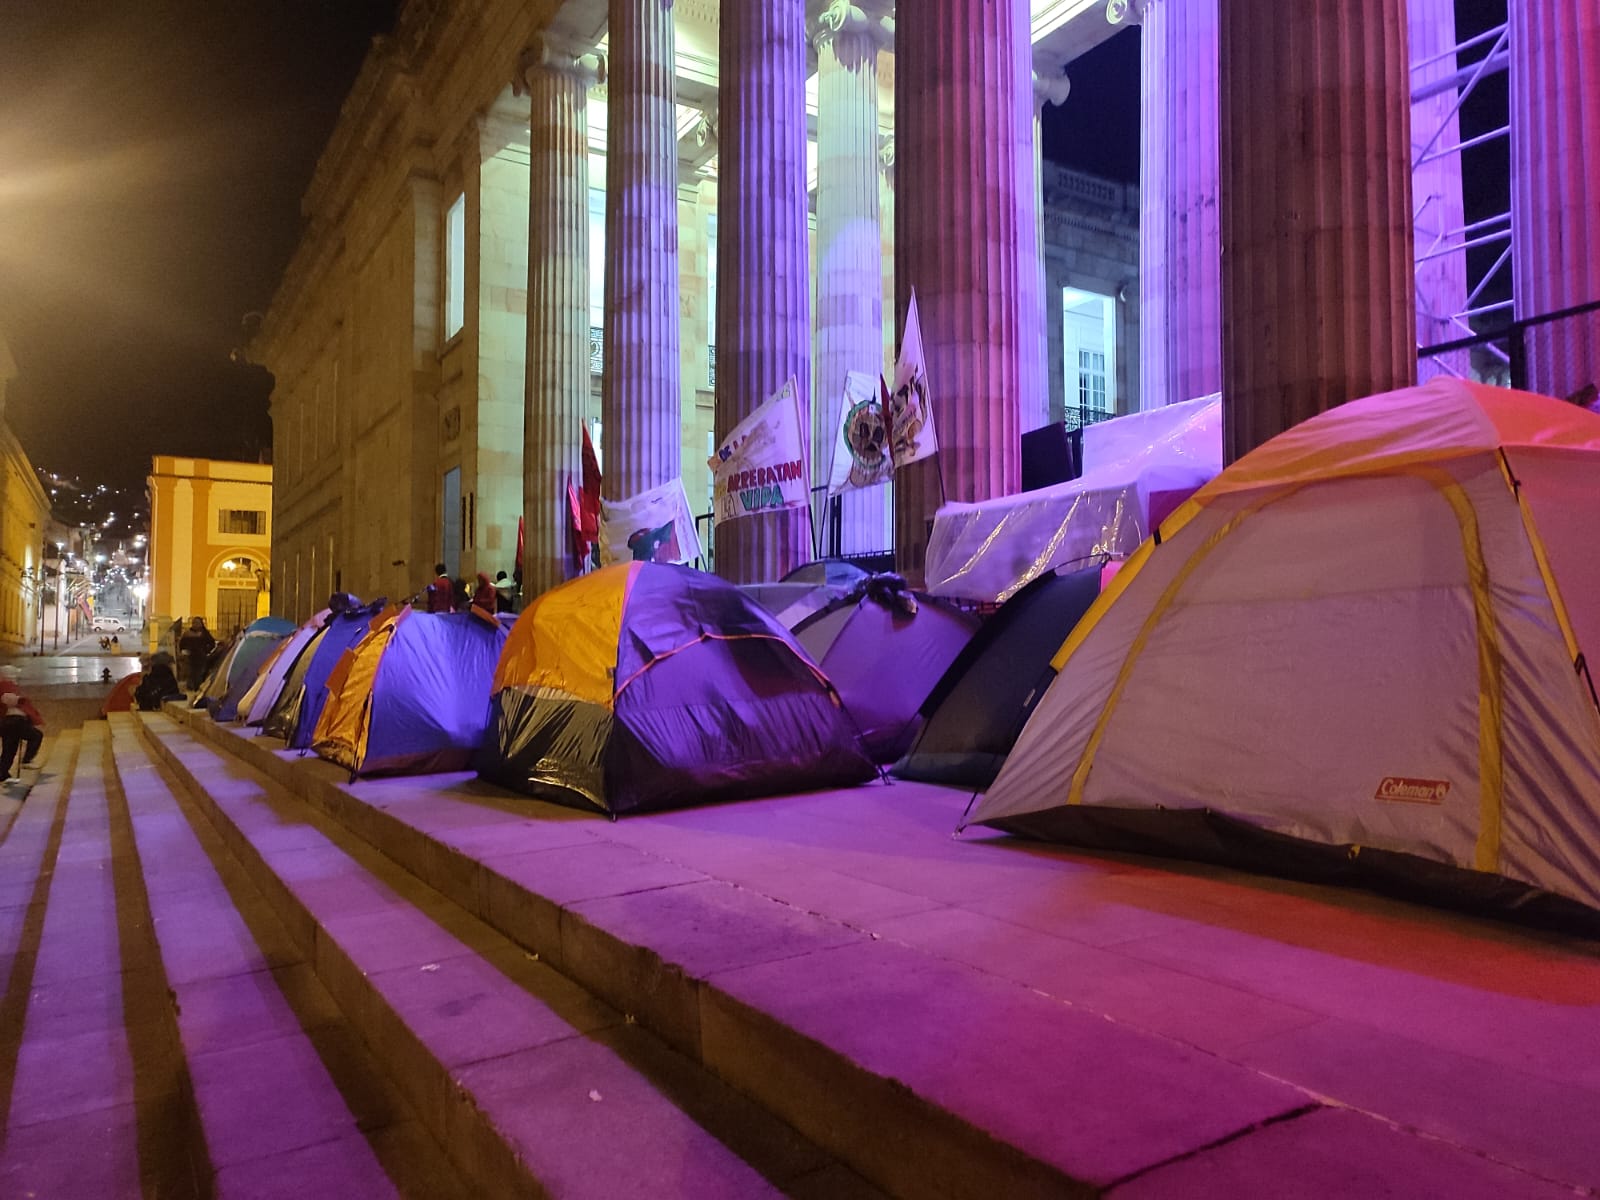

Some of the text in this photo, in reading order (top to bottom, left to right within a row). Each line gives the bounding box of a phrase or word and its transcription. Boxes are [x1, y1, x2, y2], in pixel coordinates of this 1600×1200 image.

[727, 460, 803, 493] ARREBATAN
[740, 483, 785, 511] VIDA
[1381, 778, 1434, 799] Coleman
